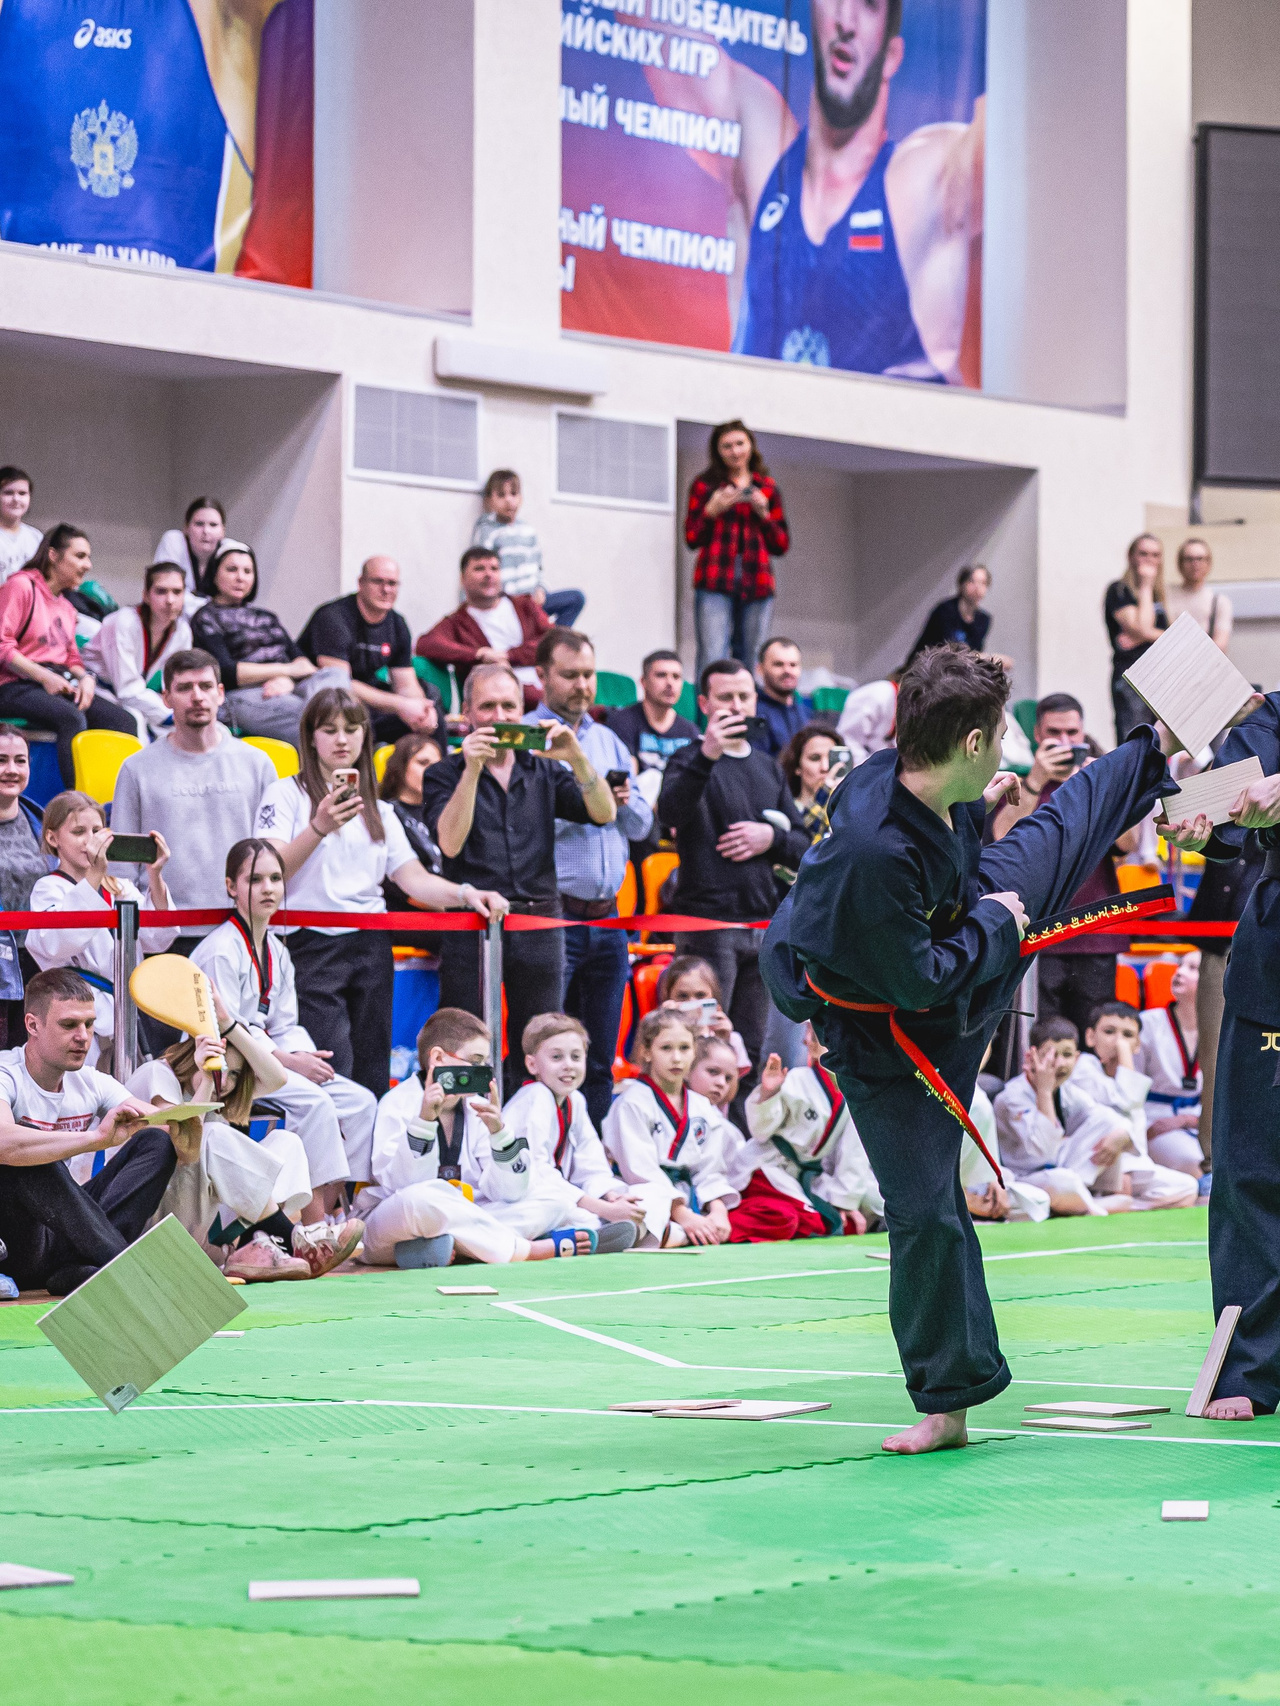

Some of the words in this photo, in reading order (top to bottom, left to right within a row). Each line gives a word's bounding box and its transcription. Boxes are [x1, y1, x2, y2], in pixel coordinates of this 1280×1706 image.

[651, 0, 808, 56] ПОБЕДИТЕЛЬ
[668, 36, 720, 79] ИГР
[614, 97, 742, 158] ЧЕМПИОН
[611, 217, 736, 275] ЧЕМПИОН
